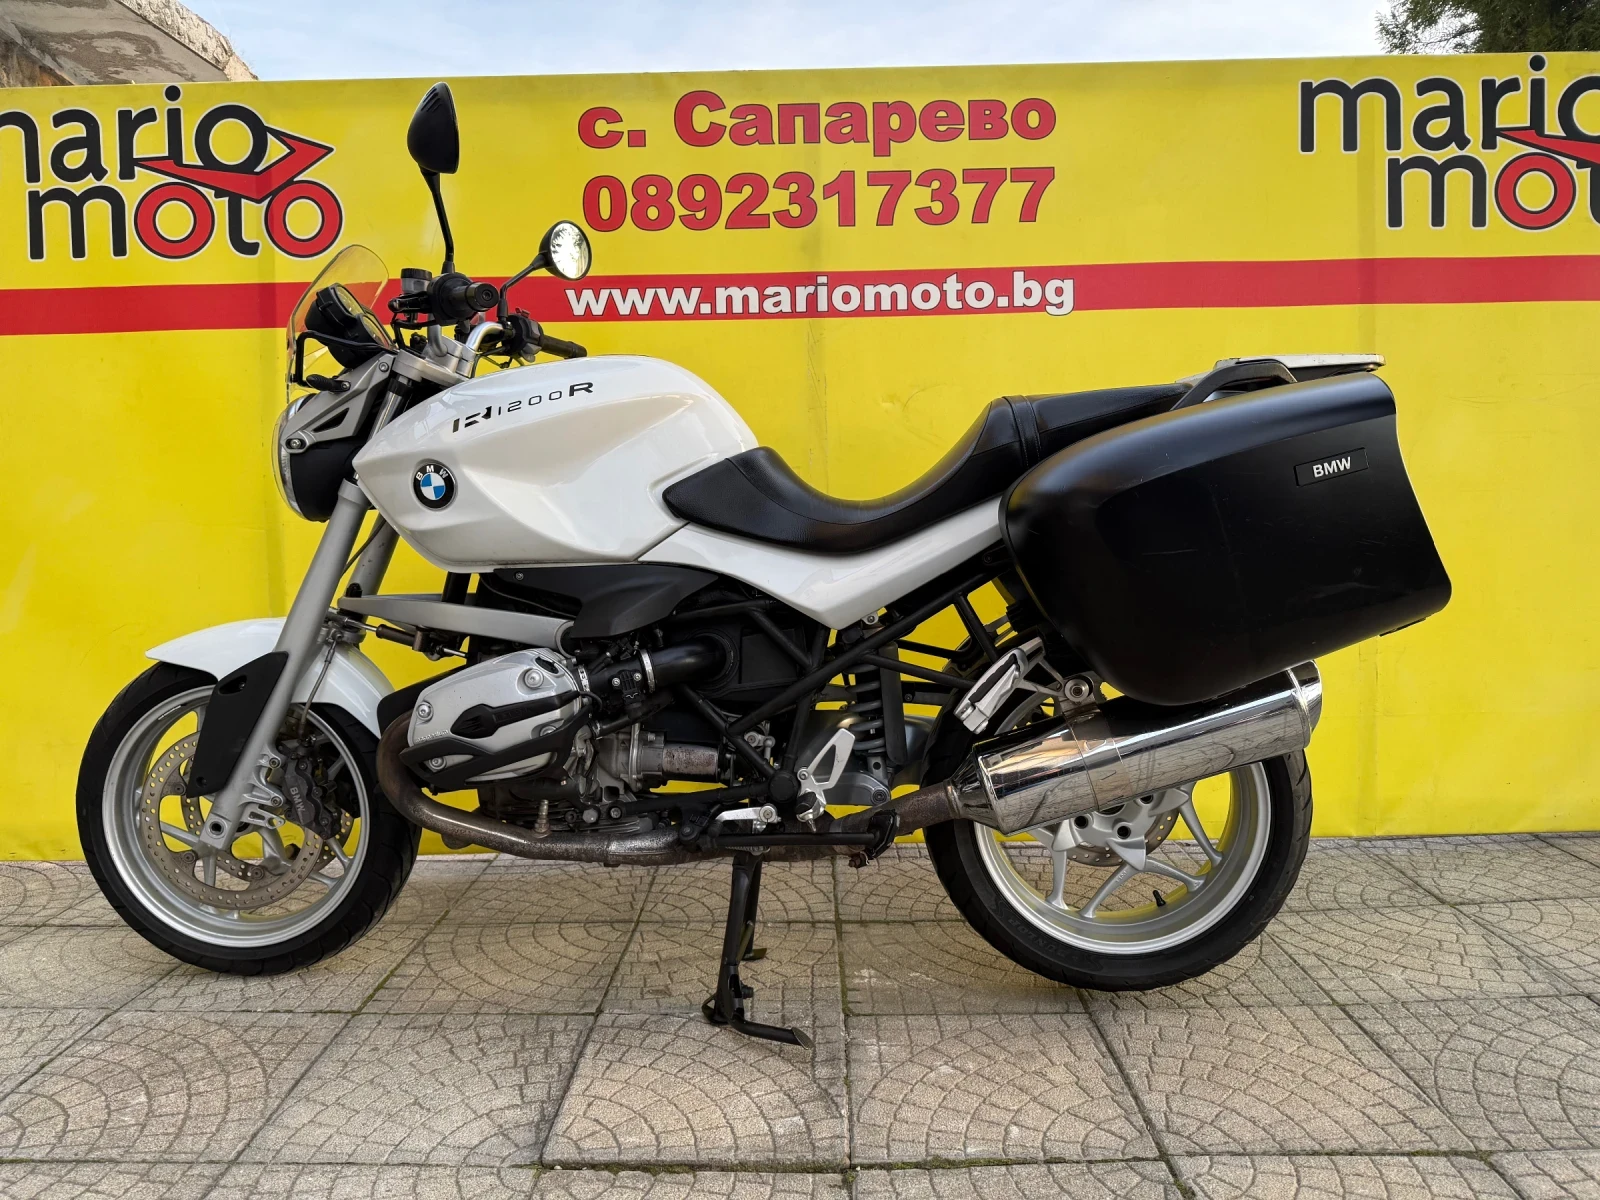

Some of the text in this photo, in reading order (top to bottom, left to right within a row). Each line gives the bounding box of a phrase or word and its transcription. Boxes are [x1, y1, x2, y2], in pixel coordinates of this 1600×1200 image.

[578, 90, 1056, 157] с. Сапарево
[28, 181, 343, 259] moto
[582, 166, 1056, 232] 0892317377
[565, 270, 1075, 317] www.mariomoto.bg
[415, 464, 449, 481] BMW
[1312, 456, 1351, 478] BMW
[290, 786, 306, 811] BMW
